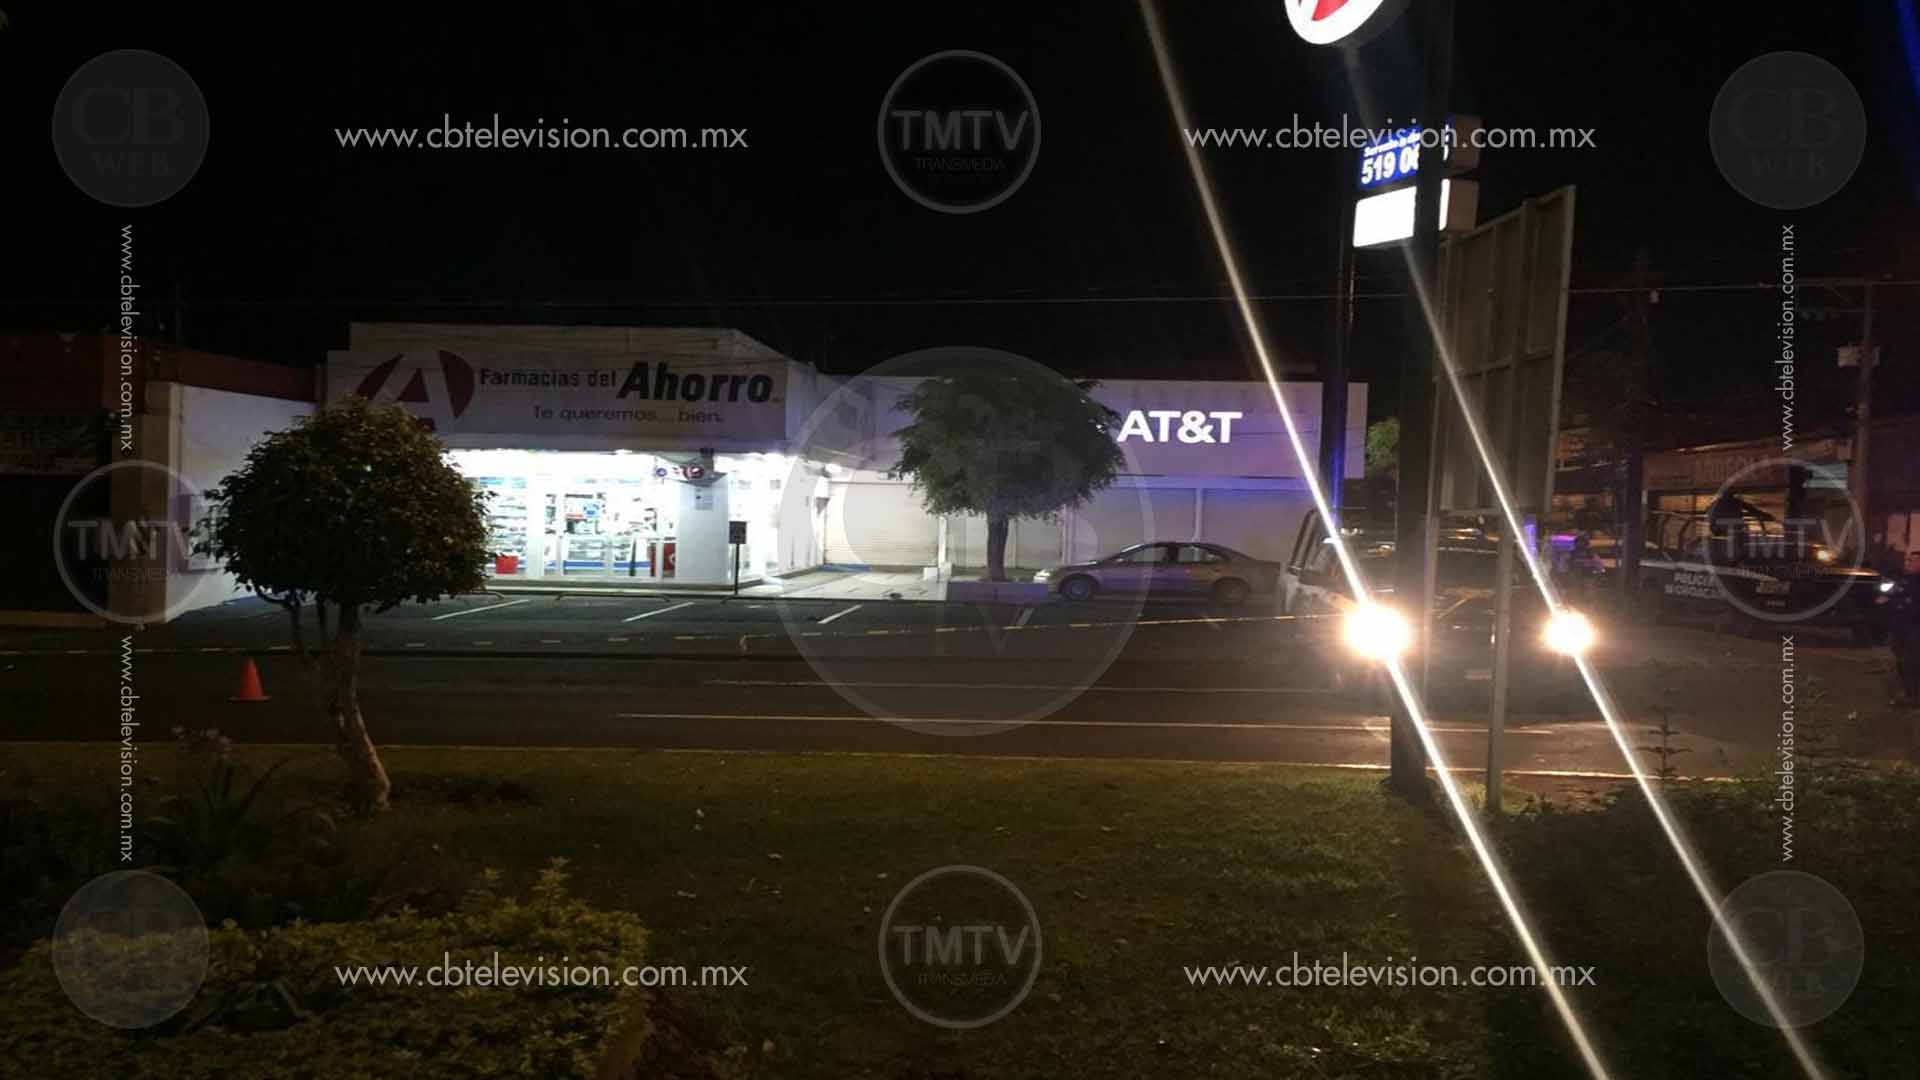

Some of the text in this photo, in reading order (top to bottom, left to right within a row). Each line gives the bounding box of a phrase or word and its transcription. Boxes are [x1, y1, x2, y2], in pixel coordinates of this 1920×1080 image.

[1361, 151, 1396, 184] 519
[480, 360, 773, 403] Farmacias del Ahorro
[533, 405, 553, 420] Te
[1116, 409, 1244, 444] AT&T
